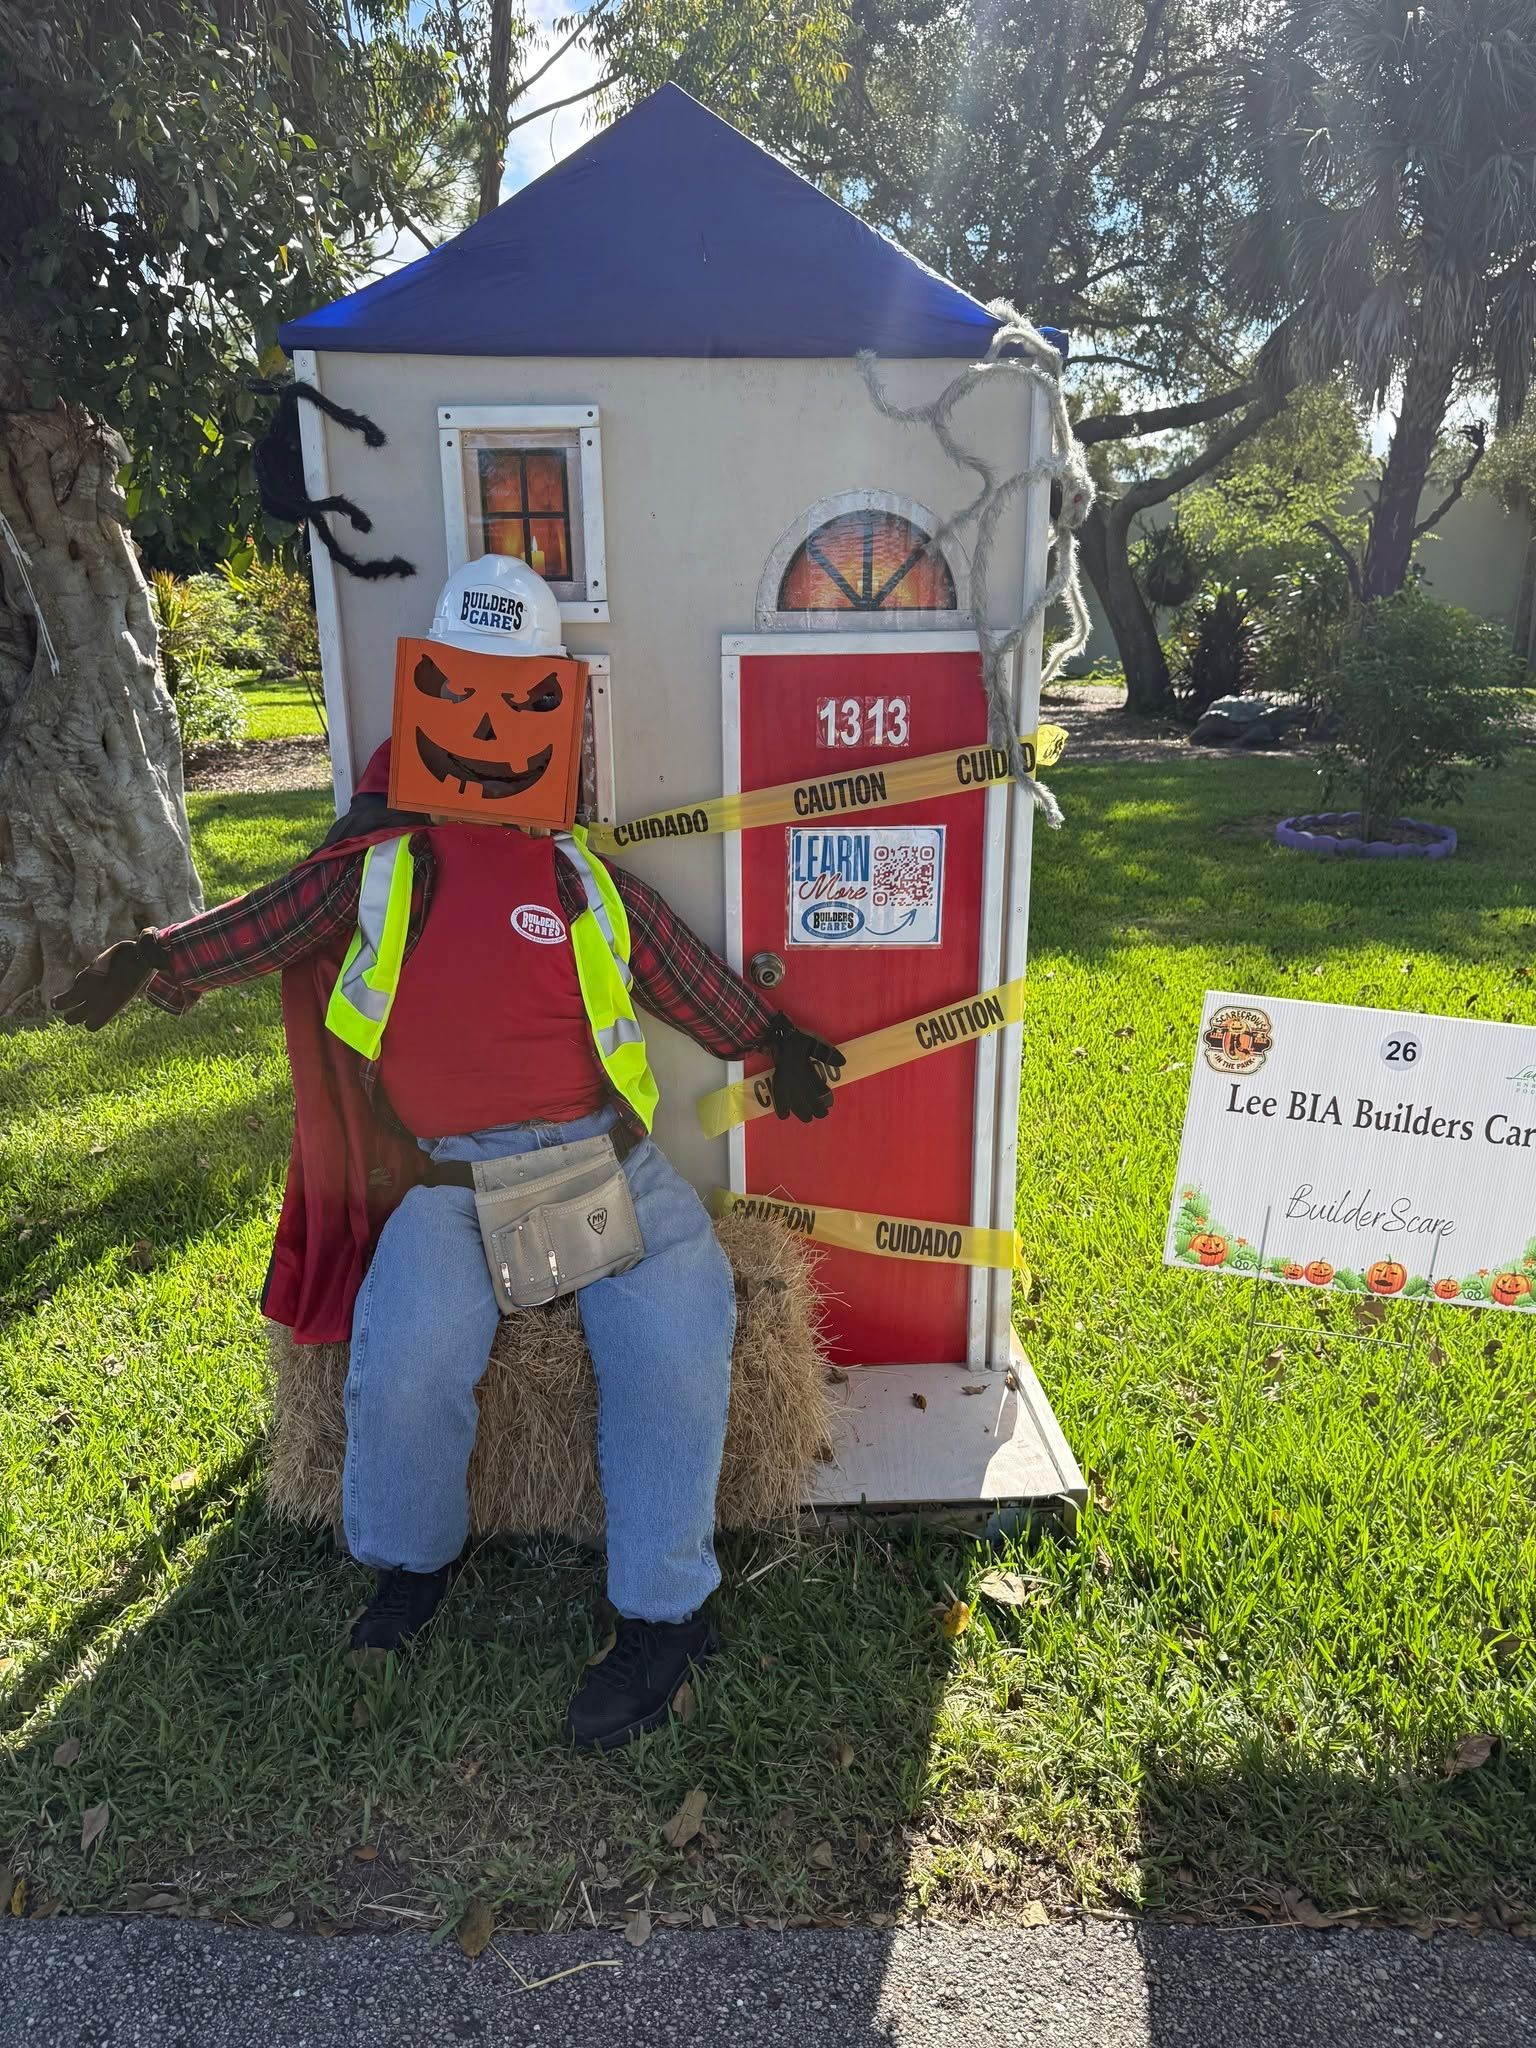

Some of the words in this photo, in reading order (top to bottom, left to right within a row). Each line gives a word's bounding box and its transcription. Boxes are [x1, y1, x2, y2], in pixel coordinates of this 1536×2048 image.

[461, 591, 524, 630] BUILDERS
[614, 809, 709, 846] CUIDADO
[794, 771, 887, 815] CAUTION
[795, 835, 870, 881] LEARN
[799, 872, 867, 900] More
[522, 912, 560, 936] BUILDERS
[813, 912, 854, 929] BUILDERS
[915, 995, 1005, 1049] CAUTION
[1215, 1010, 1267, 1030] SCARECROWS
[1215, 1055, 1221, 1063] IN
[1222, 1061, 1235, 1070] THE
[1237, 1059, 1253, 1070] PARK
[1385, 1040, 1417, 1062] 26
[1226, 1083, 1278, 1117] Lee
[1286, 1090, 1343, 1125] BIA
[1352, 1098, 1474, 1141] Builders
[732, 1199, 816, 1235] CAUTION
[876, 1220, 962, 1259] CUIDADO
[1286, 1184, 1457, 1236] BuilderScare
